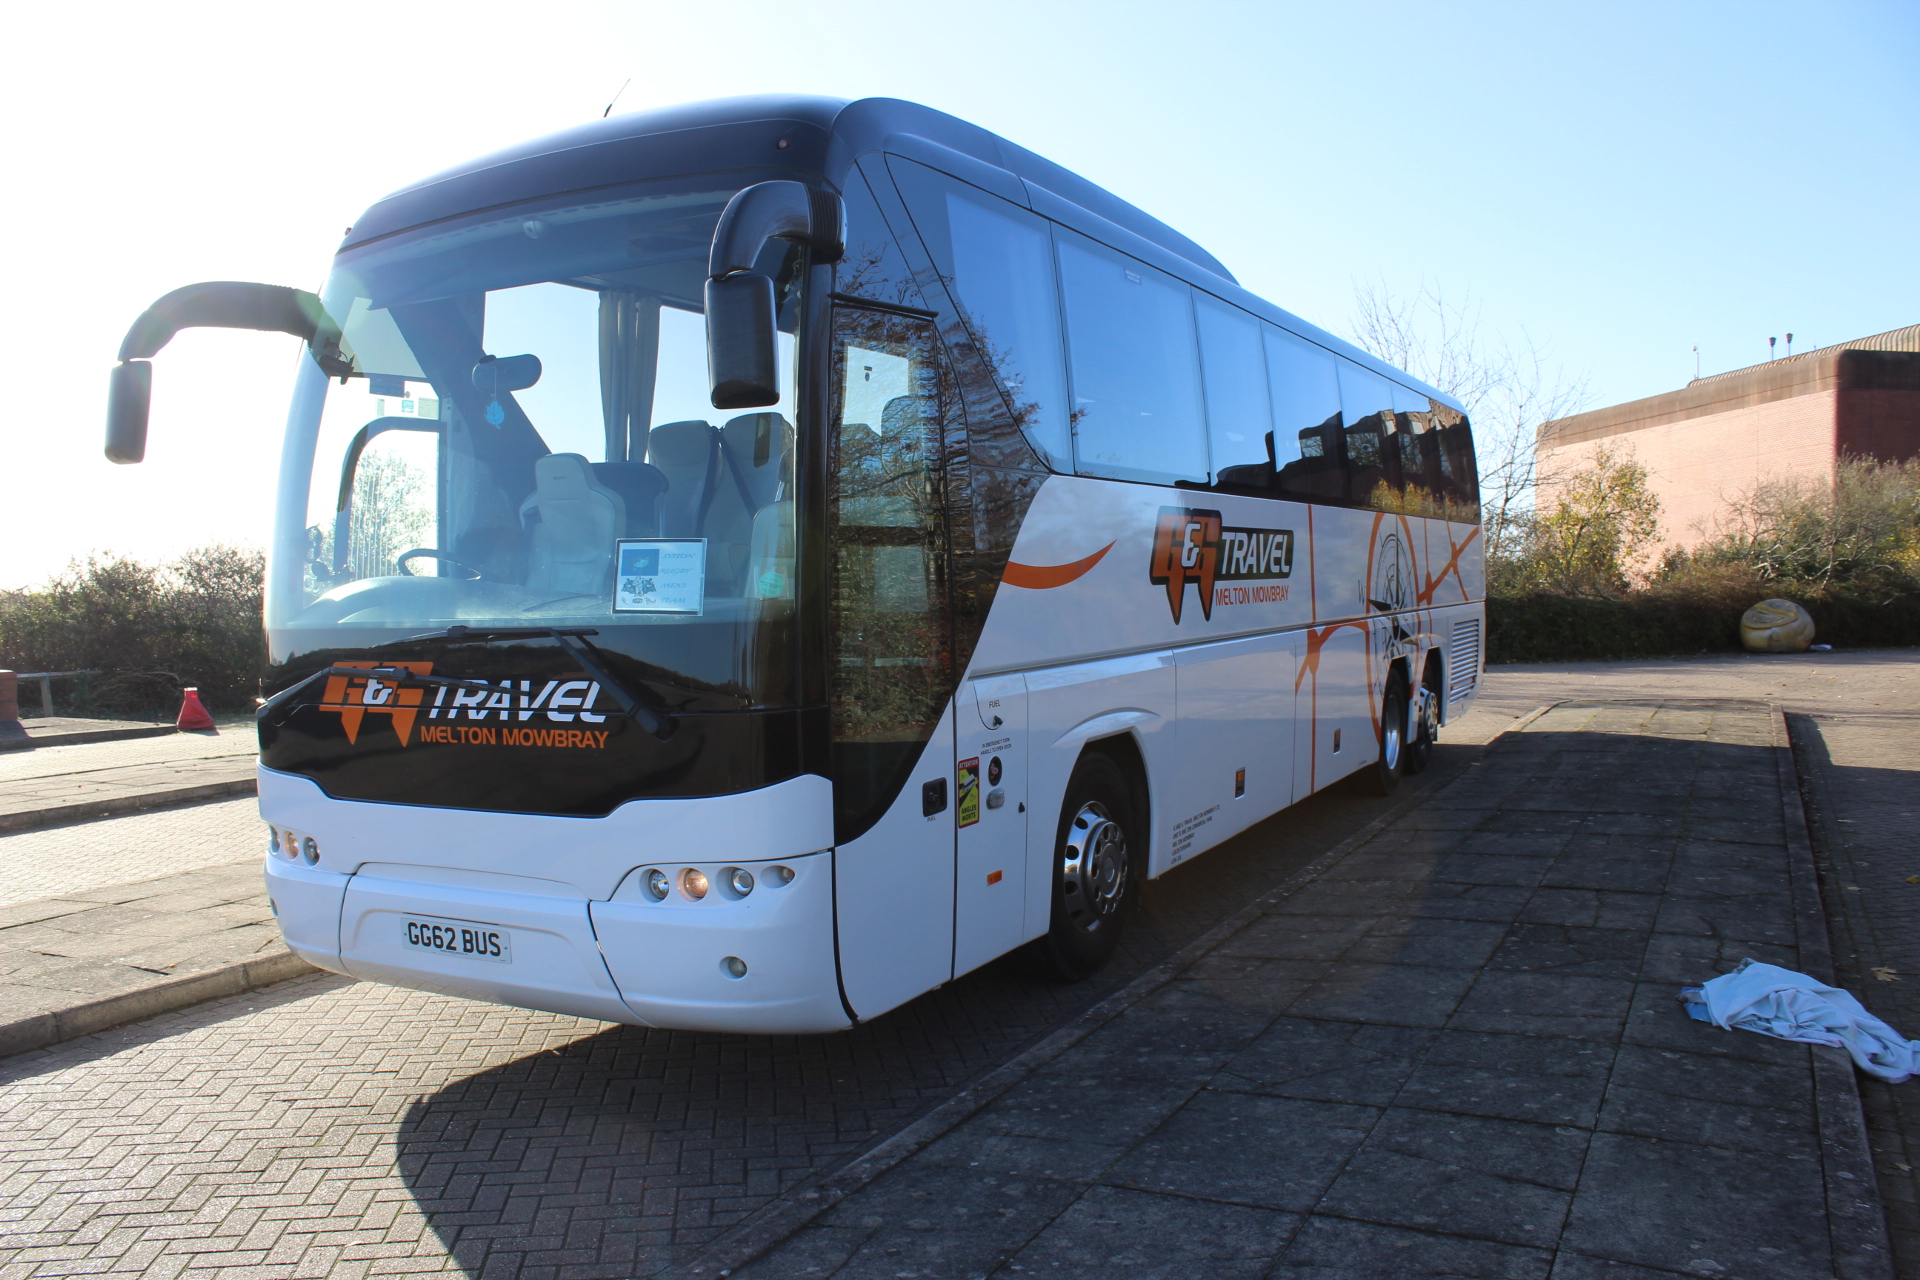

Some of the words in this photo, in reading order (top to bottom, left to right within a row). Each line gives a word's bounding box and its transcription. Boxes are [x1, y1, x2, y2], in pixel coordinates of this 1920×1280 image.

[1221, 531, 1290, 575] TRAVEL
[1215, 586, 1250, 606] MELTON
[1252, 585, 1289, 604] MOWBRAY
[428, 678, 607, 723] TRAVEL
[988, 699, 1001, 709] FUEL
[420, 726, 496, 745] MELTON
[502, 727, 609, 749] MOWBRAY
[958, 758, 979, 769] ATTENTION
[961, 804, 977, 814] ANGLES
[407, 922, 457, 951] GG62
[461, 929, 501, 957] BUS
